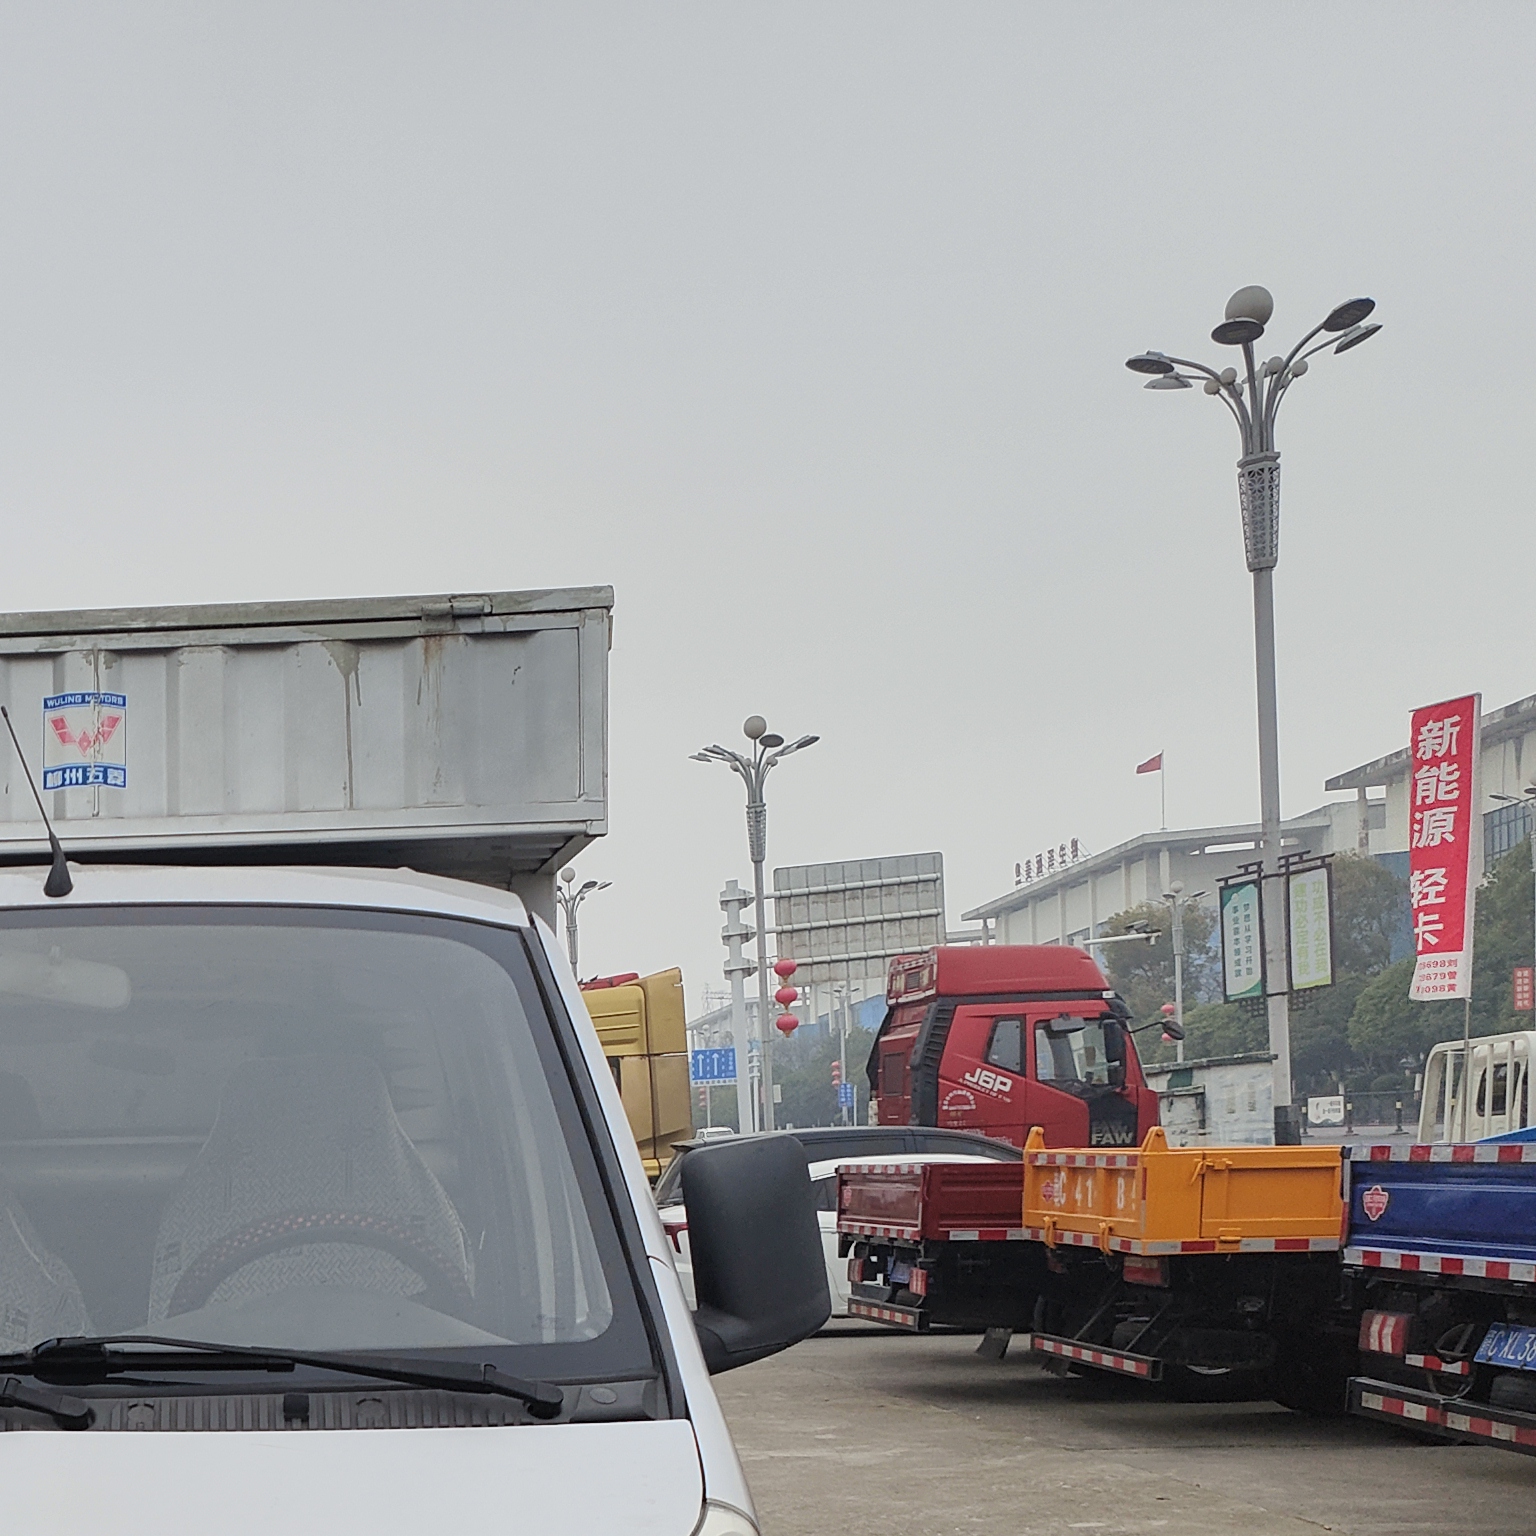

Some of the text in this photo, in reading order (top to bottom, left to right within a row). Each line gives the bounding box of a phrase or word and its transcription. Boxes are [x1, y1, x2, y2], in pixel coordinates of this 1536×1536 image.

[46, 694, 83, 708] WULING
[1409, 714, 1461, 951] 新能源 轻卡
[964, 1067, 1013, 1093] J6P
[1090, 1132, 1134, 1146] FAW
